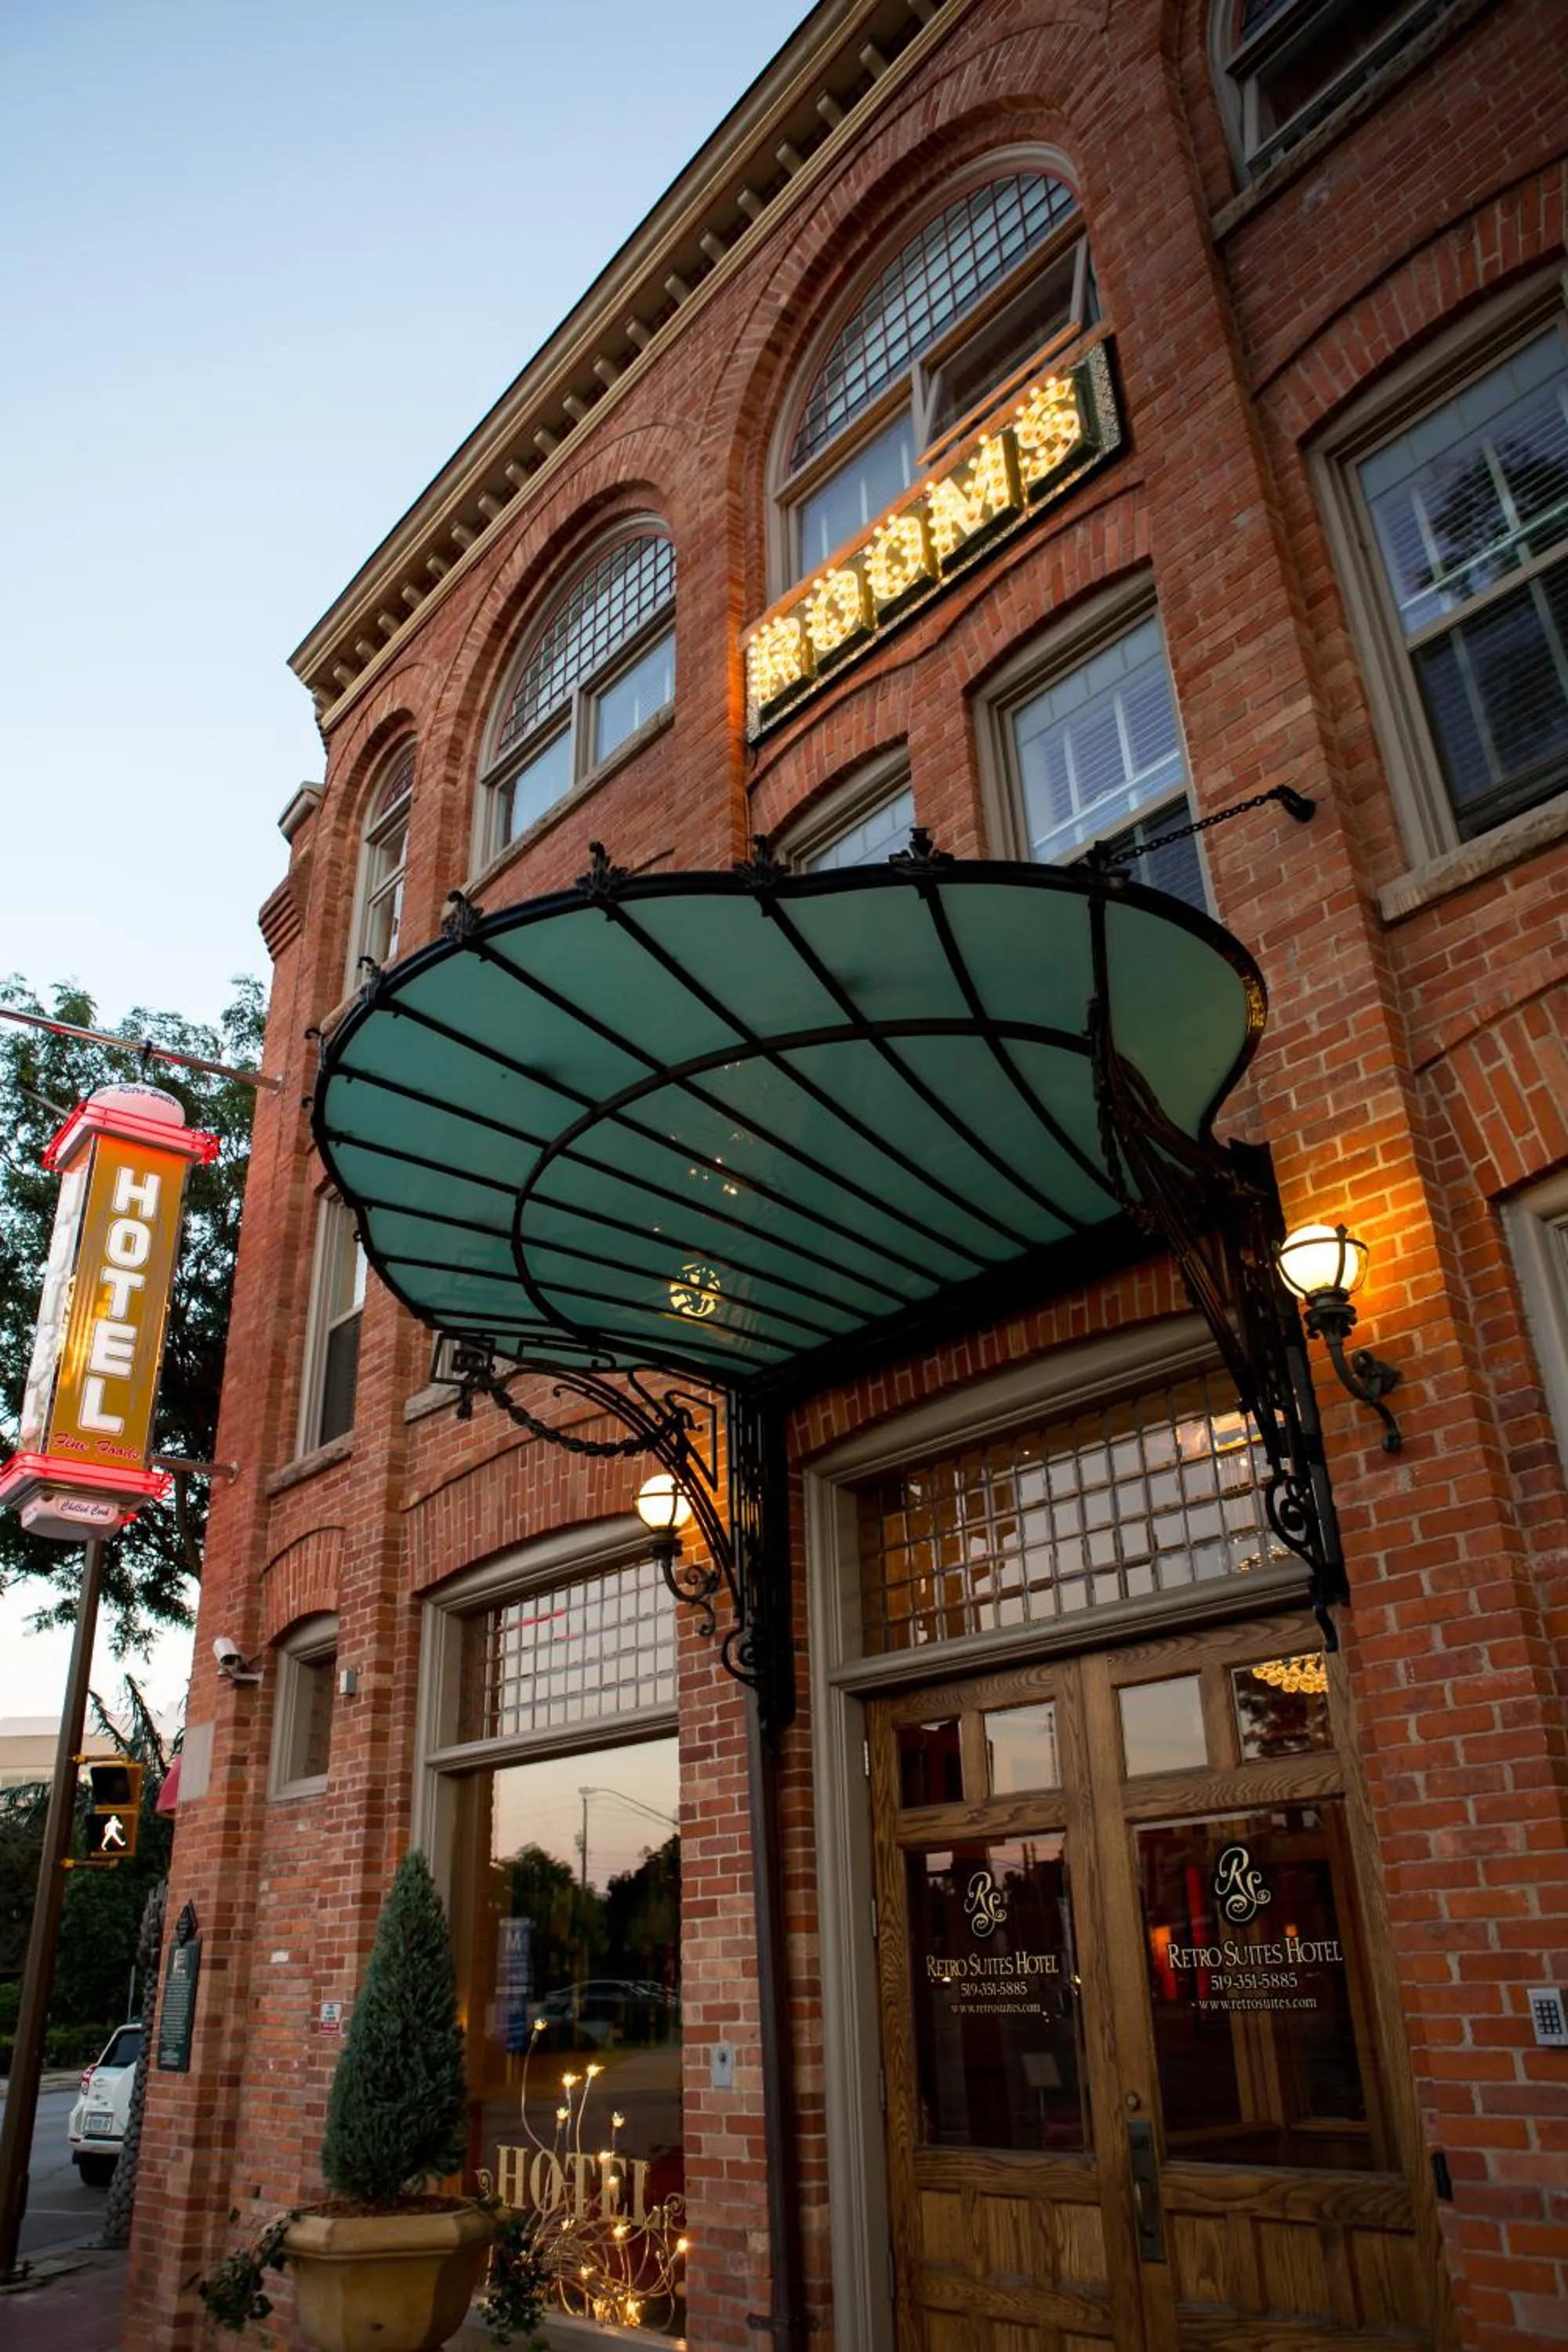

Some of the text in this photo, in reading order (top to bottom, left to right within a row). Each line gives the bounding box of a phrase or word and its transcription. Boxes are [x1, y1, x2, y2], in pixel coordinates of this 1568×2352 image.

[750, 376, 1082, 706] ROOMS
[79, 1166, 162, 1435] HOTEL
[95, 1439, 142, 1461] Foods
[960, 1981, 1029, 1998] 519-351-5885
[1210, 1973, 1298, 1991] 519-351-5885
[1199, 1998, 1317, 2010] www.retrosuites.com
[497, 2145, 661, 2229] HOTEL
